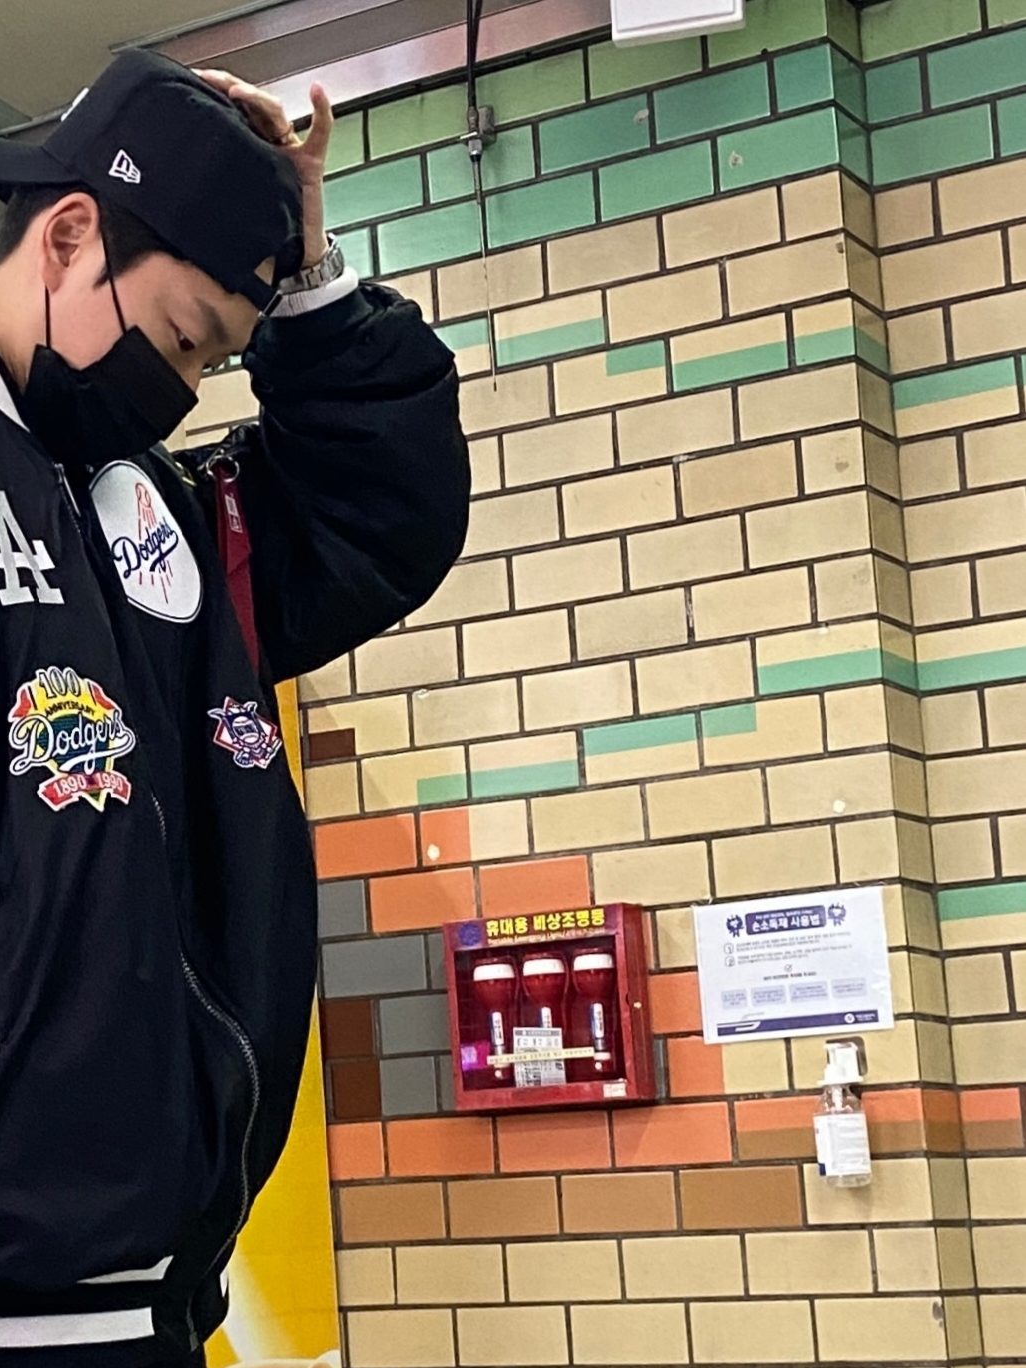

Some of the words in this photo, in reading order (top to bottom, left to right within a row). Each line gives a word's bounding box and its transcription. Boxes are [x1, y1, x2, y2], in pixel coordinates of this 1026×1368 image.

[111, 517, 178, 579] Dodgers
[39, 668, 81, 699] 100
[45, 700, 96, 717] ANNIVERSARY
[9, 710, 136, 775] Dodgers
[53, 775, 87, 797] 1890
[97, 773, 123, 790] 1990
[486, 916, 528, 937] 휴대용
[533, 908, 605, 931] 비상조명등
